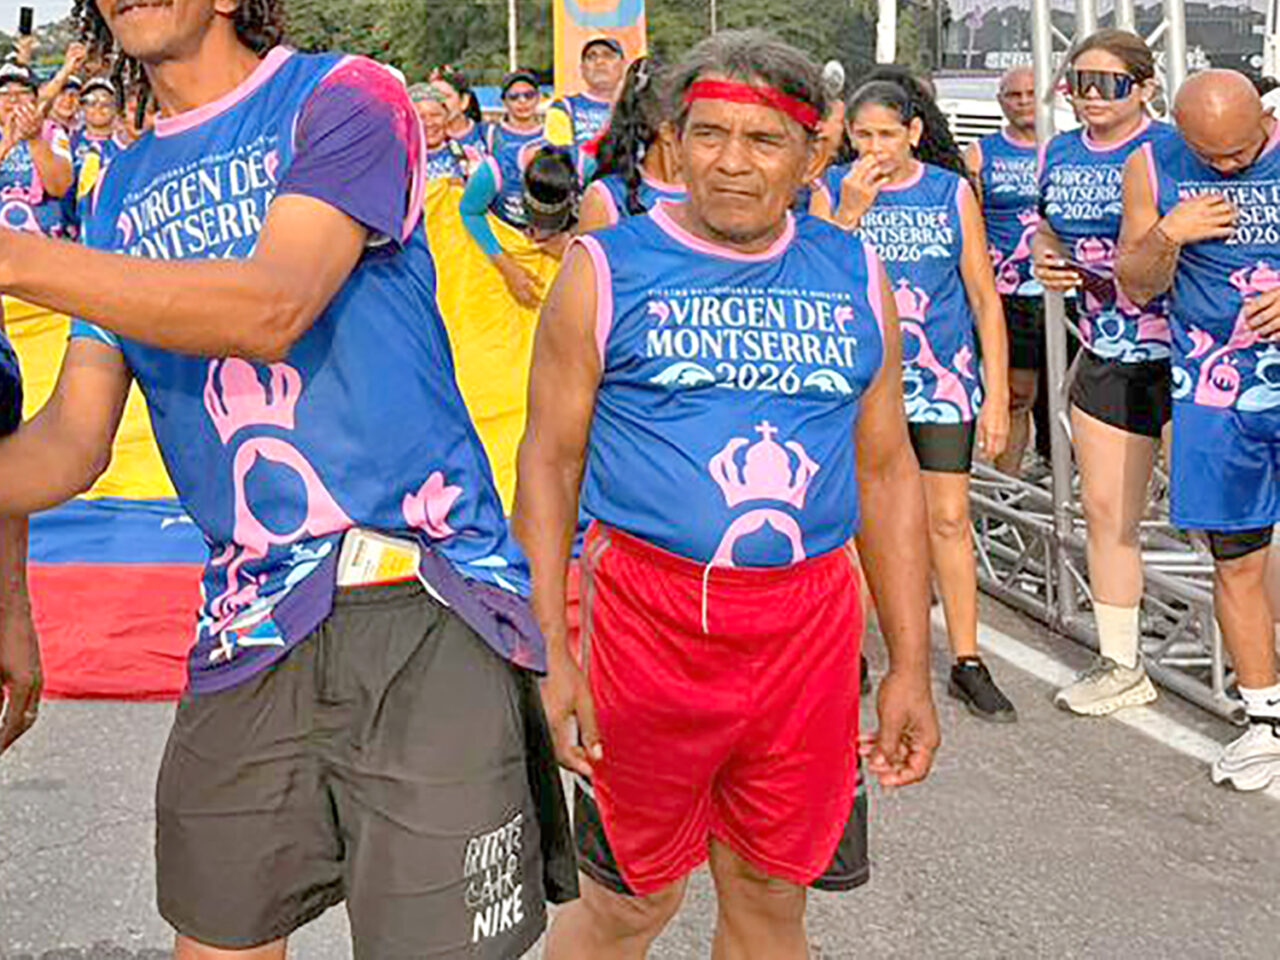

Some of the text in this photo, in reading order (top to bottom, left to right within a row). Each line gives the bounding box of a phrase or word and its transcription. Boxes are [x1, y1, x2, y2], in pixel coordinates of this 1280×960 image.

[129, 166, 222, 235] VIRGEN
[230, 151, 269, 197] DE
[860, 210, 939, 229] IRGEN DE
[1062, 202, 1102, 220] 2026
[852, 226, 953, 245] ONTSERRAT
[876, 243, 922, 263] 2026
[669, 296, 835, 333] VIRGEN DE
[646, 328, 857, 368] MONTSERRAT
[714, 361, 801, 395] 2026
[473, 884, 524, 943] NIKE
